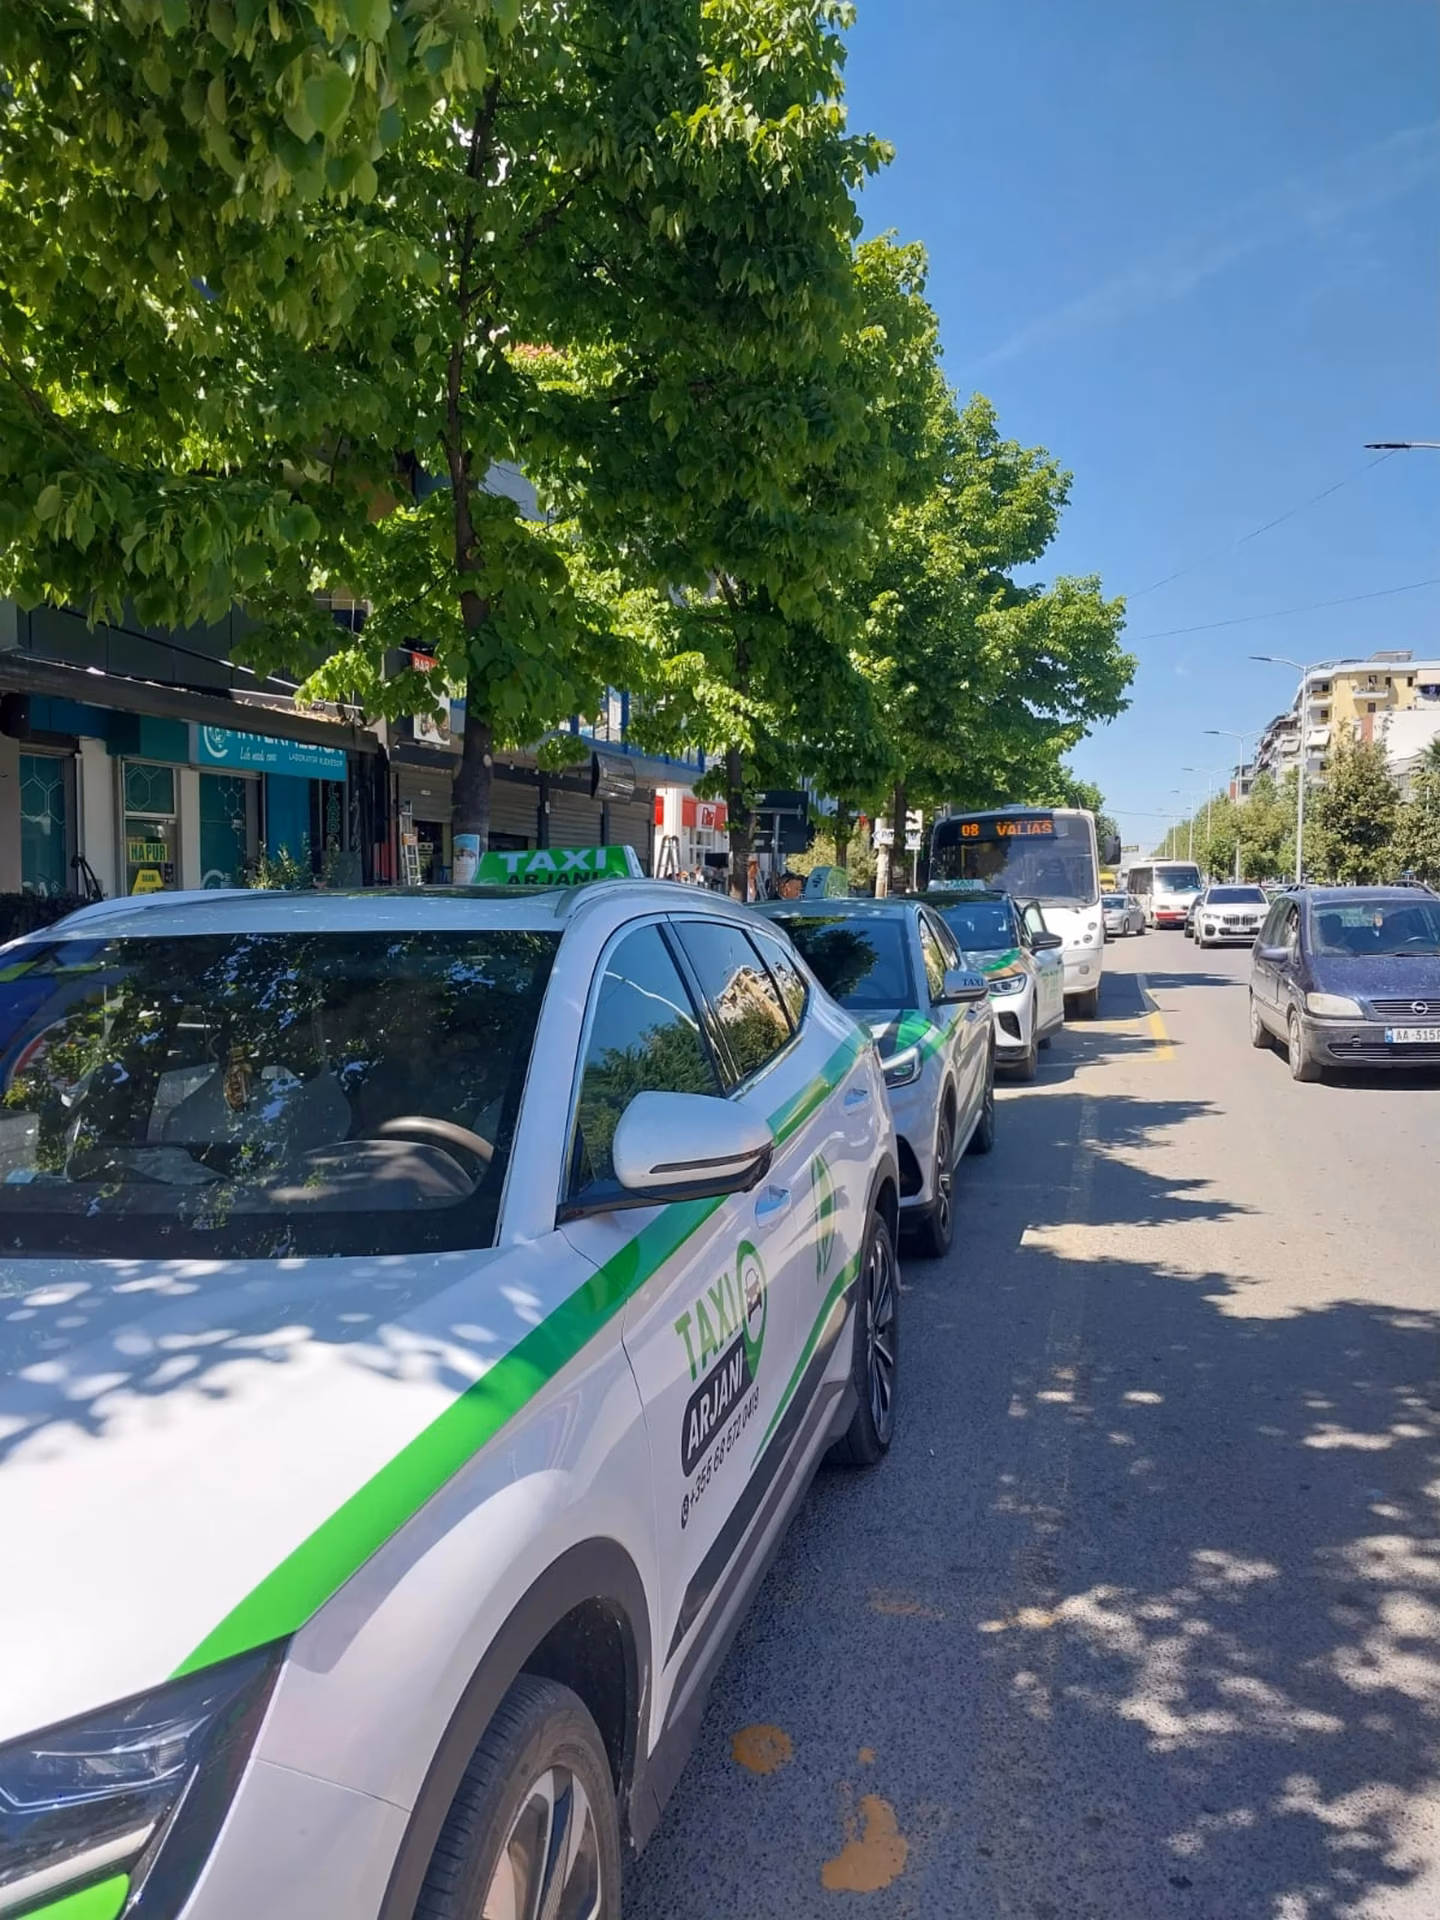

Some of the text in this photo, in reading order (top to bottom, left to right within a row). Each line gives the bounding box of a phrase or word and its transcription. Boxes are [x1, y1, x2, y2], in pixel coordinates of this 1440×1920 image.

[961, 820, 1053, 836] 08 VALIAS
[498, 849, 606, 873] TAXI
[508, 871, 599, 886] ARJANI
[963, 978, 984, 987] TAXI
[674, 1272, 739, 1383] TAXI
[687, 1347, 743, 1460] ARJANI
[690, 1455, 713, 1508] +355
